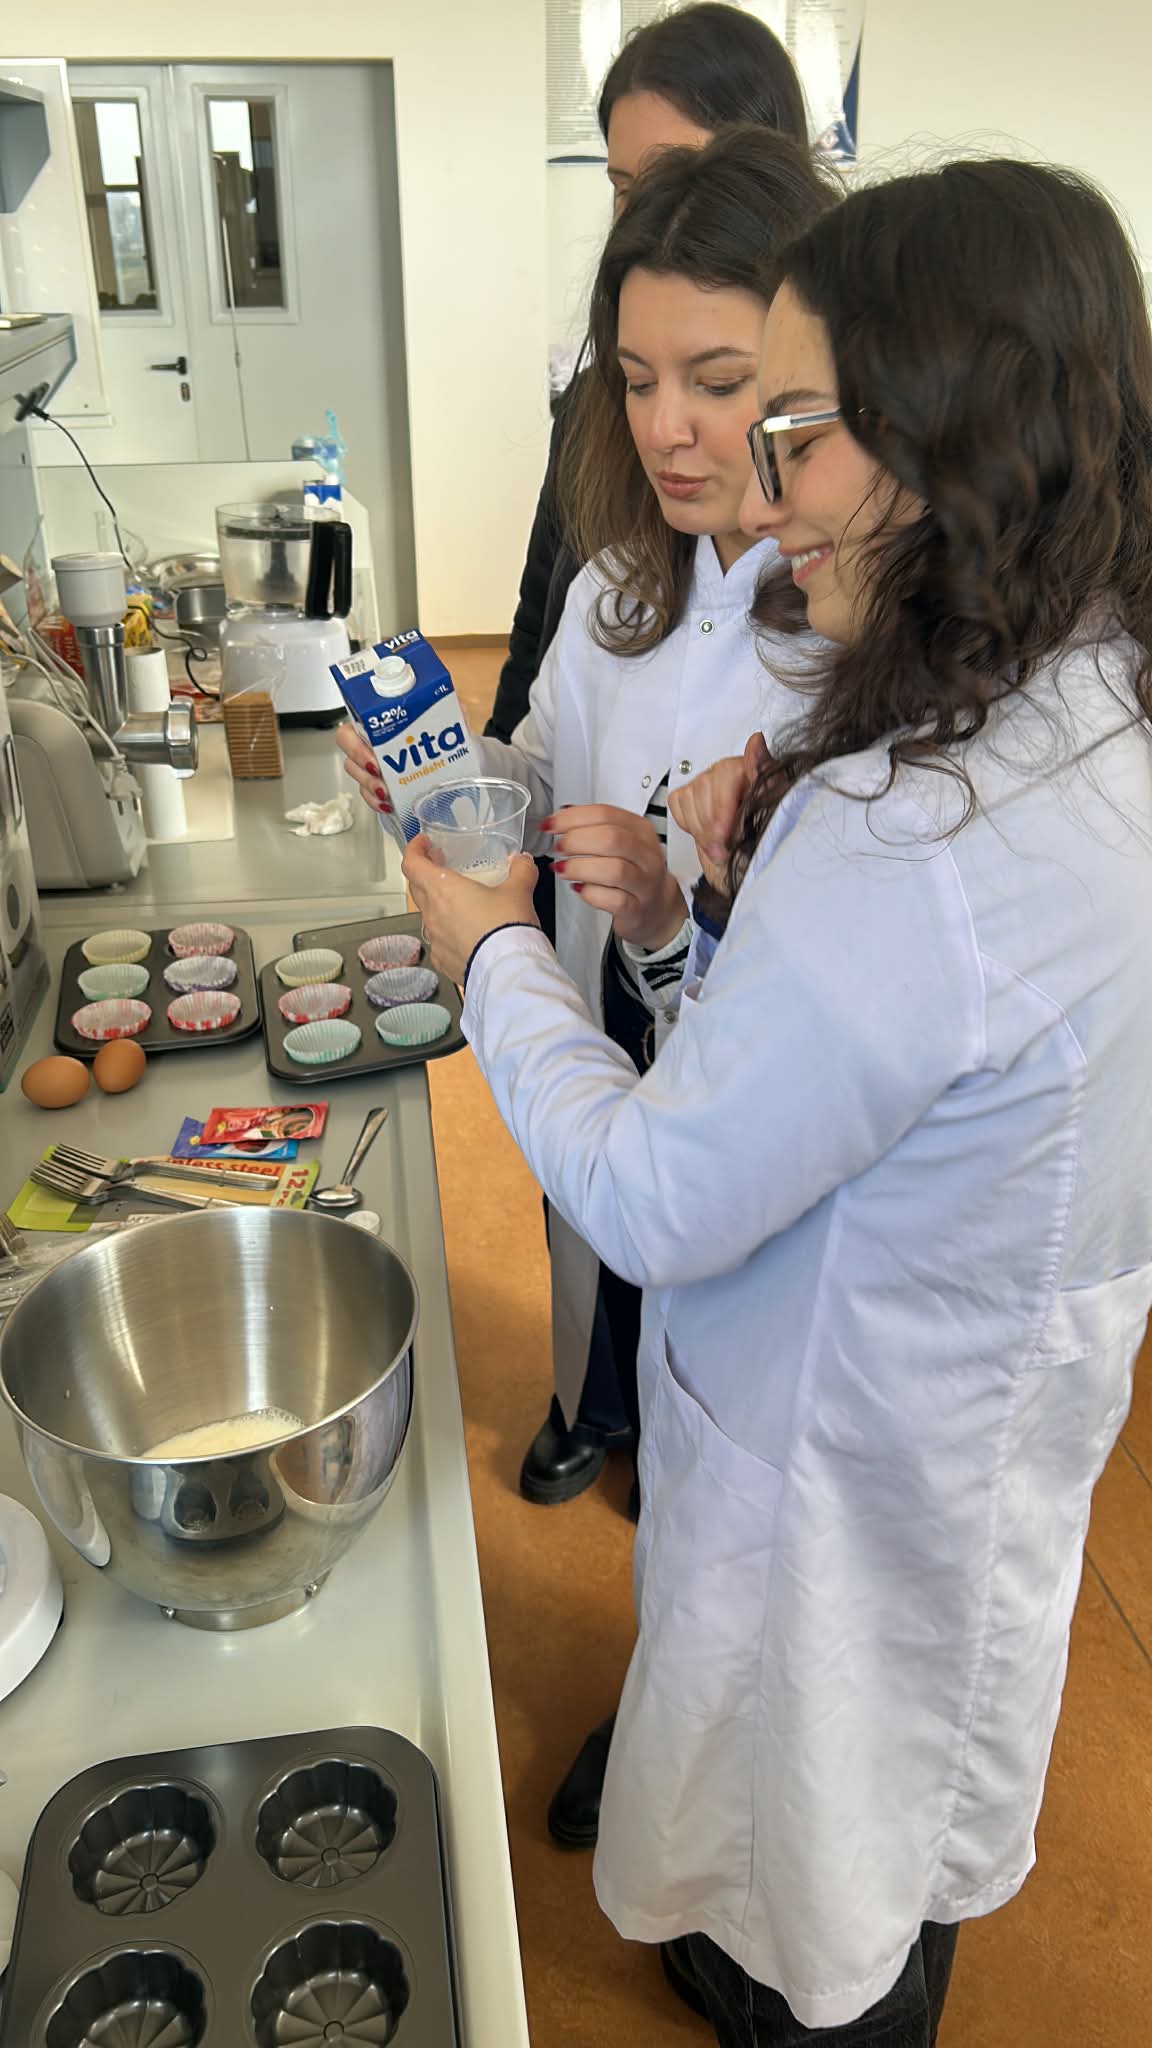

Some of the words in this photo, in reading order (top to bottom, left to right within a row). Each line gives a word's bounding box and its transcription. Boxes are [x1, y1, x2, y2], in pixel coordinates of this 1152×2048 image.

[384, 630, 419, 650] vita
[368, 705, 407, 729] 3,2%
[382, 722, 466, 774] vita
[447, 746, 470, 764] milk
[286, 1168, 310, 1189] 12
